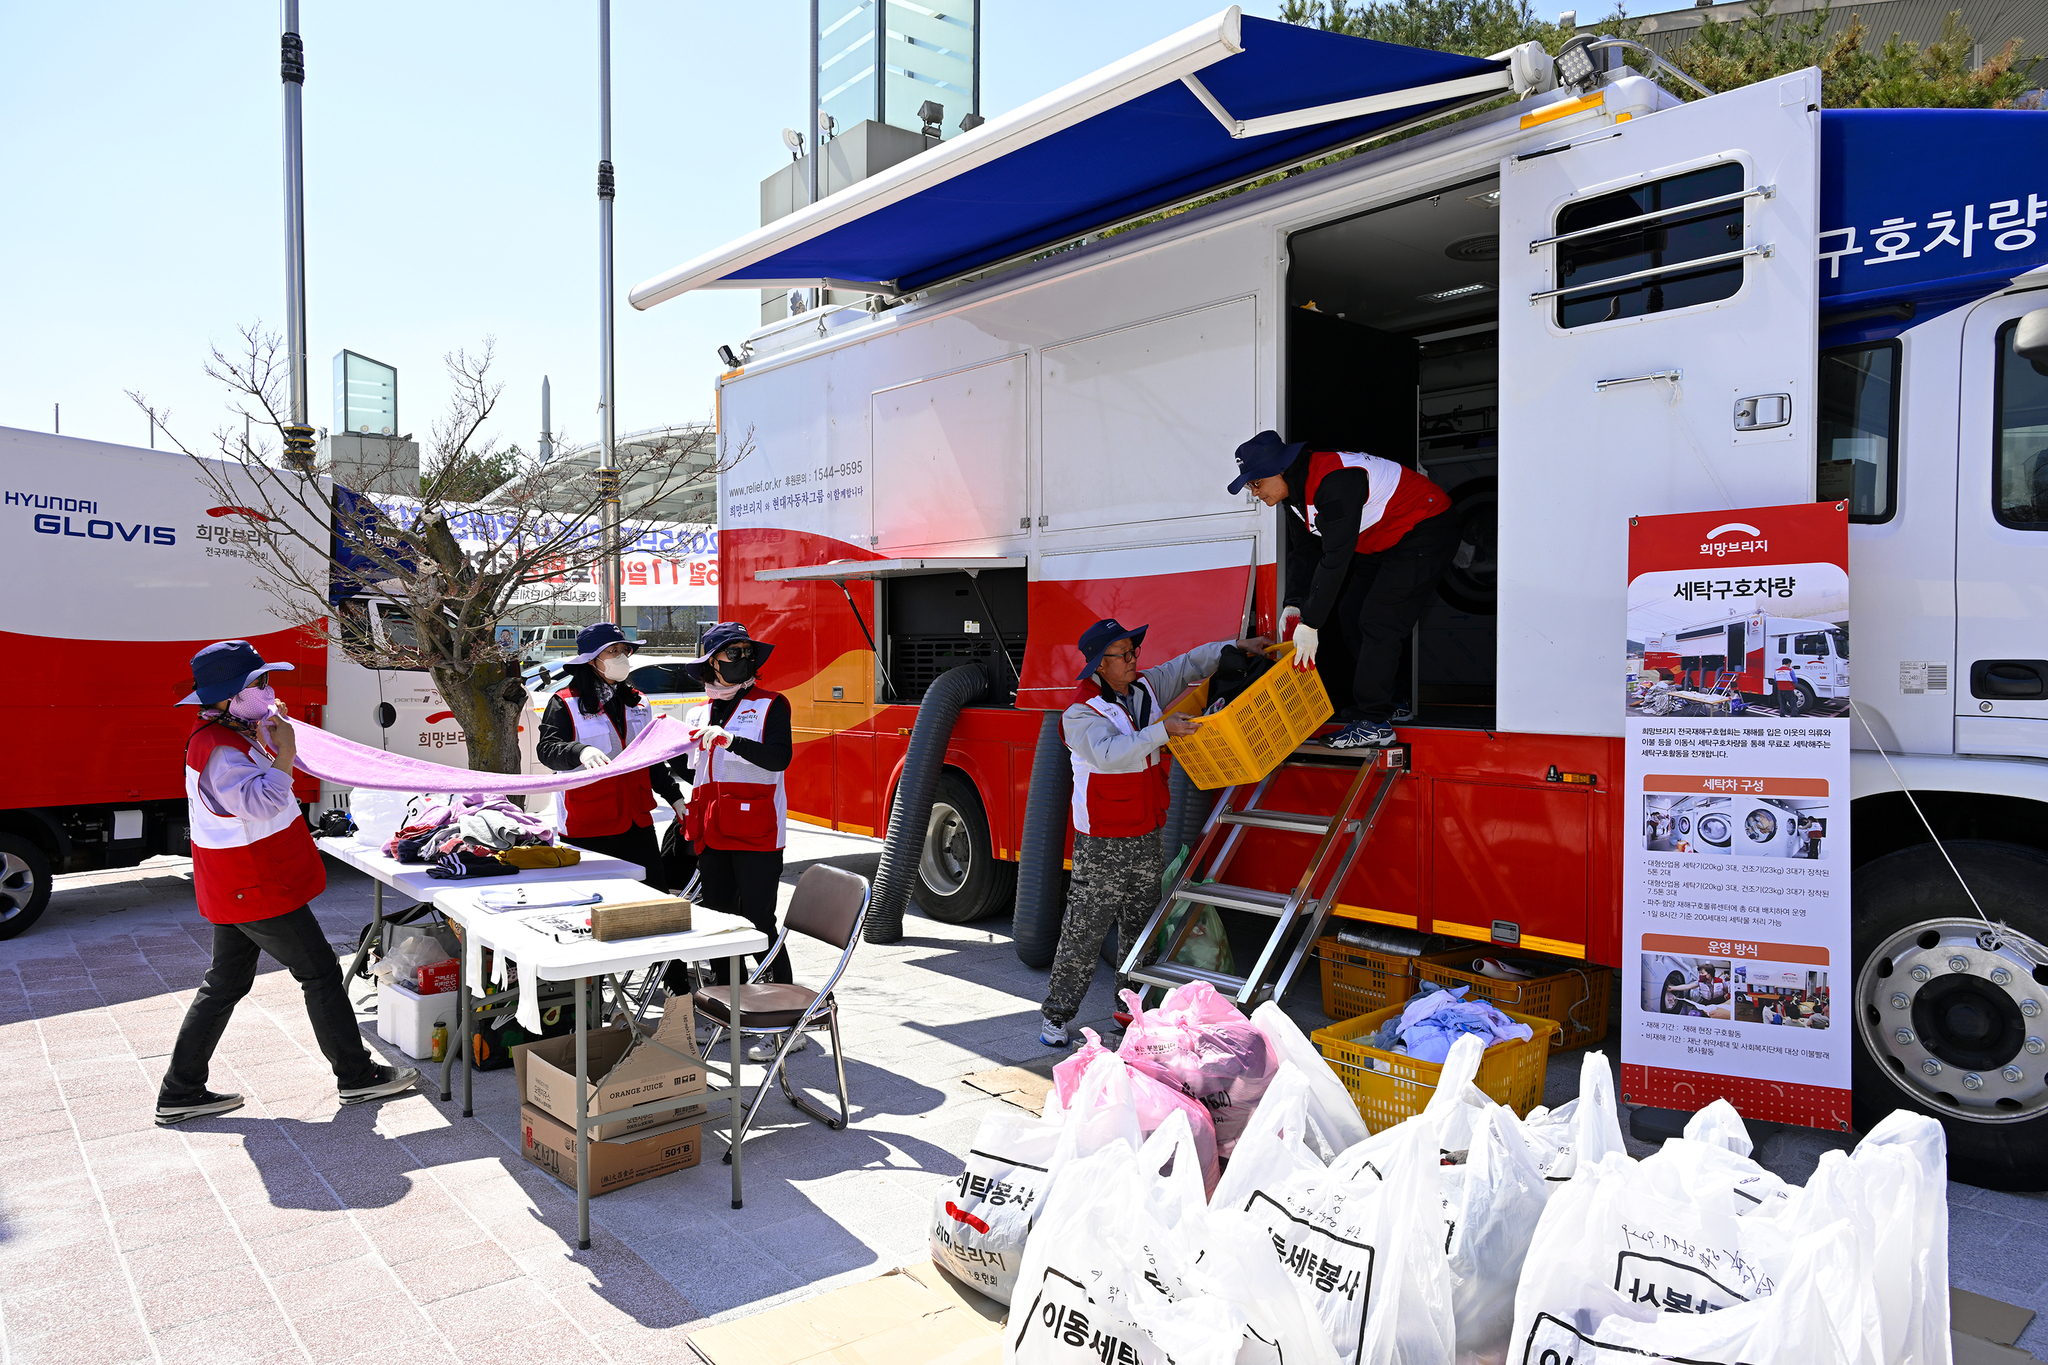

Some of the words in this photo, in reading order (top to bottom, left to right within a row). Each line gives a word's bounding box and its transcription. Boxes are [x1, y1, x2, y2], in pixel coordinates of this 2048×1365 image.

[1817, 194, 2048, 279] 구호차량
[729, 477, 782, 497] www.relief.or.kr
[785, 473, 807, 487] 후원문의
[814, 461, 863, 481] 1544-9595
[5, 490, 98, 515] HYUNDAI
[729, 500, 763, 518] 희망브리지
[764, 503, 770, 511] 와
[772, 489, 824, 511] 현대자동차그룹
[833, 486, 863, 500] 함께합니다
[33, 513, 176, 546] GLOVIS
[1700, 539, 1768, 557] 희망브리지
[1673, 576, 1796, 601] 세탁구호차량
[418, 732, 466, 749] 희망브리
[1678, 728, 1740, 736] 전국재해구호협회는
[1808, 729, 1831, 737] 의류와
[1675, 739, 1695, 747] 이동식
[1751, 740, 1765, 748] 통해
[1768, 740, 1790, 748] 무료로
[1703, 778, 1737, 792] 세탁차
[1741, 780, 1764, 792] 구성
[1648, 860, 1680, 868] 대형산업용
[1683, 862, 1723, 871] 세탁기(20kg)
[1742, 865, 1784, 875] 건조기(23kg)
[1808, 869, 1829, 877] 장착된
[1648, 880, 1680, 888] 대형산업용
[1682, 882, 1723, 891] 세탁기(20kg)
[1742, 885, 1784, 895] 건조기(23kg)
[1786, 888, 1805, 896] 3대가
[1808, 889, 1829, 898] 장착된
[1677, 901, 1737, 912] 재해구호물류센터에
[1762, 907, 1789, 915] 배치하여
[1792, 909, 1806, 917] 운영
[1648, 910, 1658, 918] 1일
[1660, 911, 1677, 919] 8시간
[1695, 914, 1727, 922] 200세대의
[1768, 919, 1782, 927] 가능
[1708, 941, 1731, 954] 운영
[1735, 943, 1758, 957] 방식
[1661, 1023, 1674, 1031] 기간
[1683, 1025, 1696, 1033] 재해
[1699, 1027, 1712, 1035] 현장
[1714, 1028, 1741, 1038] 구호활동
[1646, 1033, 1666, 1041] 비재해
[1668, 1035, 1681, 1043] 기간
[1687, 1037, 1700, 1045] 재난
[1703, 1039, 1730, 1048] 취약세대
[1741, 1043, 1782, 1054] 사회복지단체
[1785, 1048, 1798, 1056] 대상
[1801, 1050, 1829, 1059] 이불빨래
[1687, 1046, 1714, 1056] 봉사활동
[610, 1087, 641, 1099] ORANGE
[643, 1082, 663, 1093] JUICE
